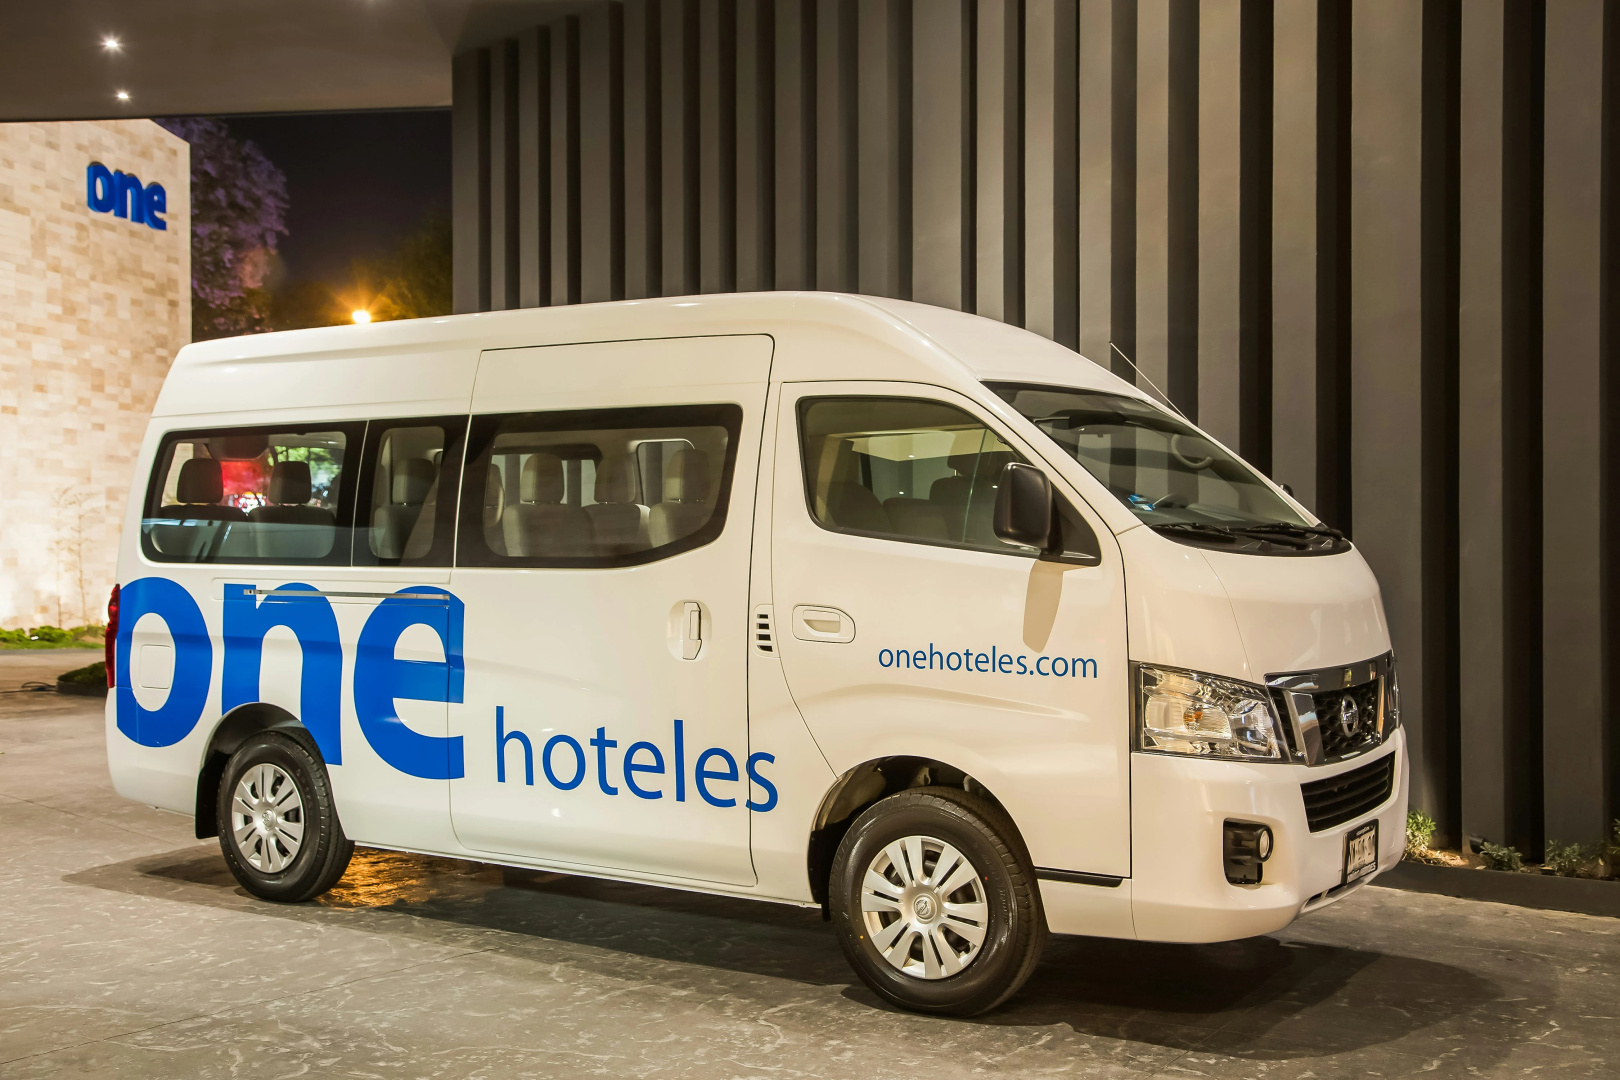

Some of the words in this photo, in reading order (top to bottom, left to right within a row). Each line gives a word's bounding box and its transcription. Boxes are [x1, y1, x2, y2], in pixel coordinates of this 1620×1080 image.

[86, 160, 167, 230] one
[115, 576, 465, 780] one
[877, 642, 1098, 679] onehoteles.com
[495, 705, 779, 813] hoteles
